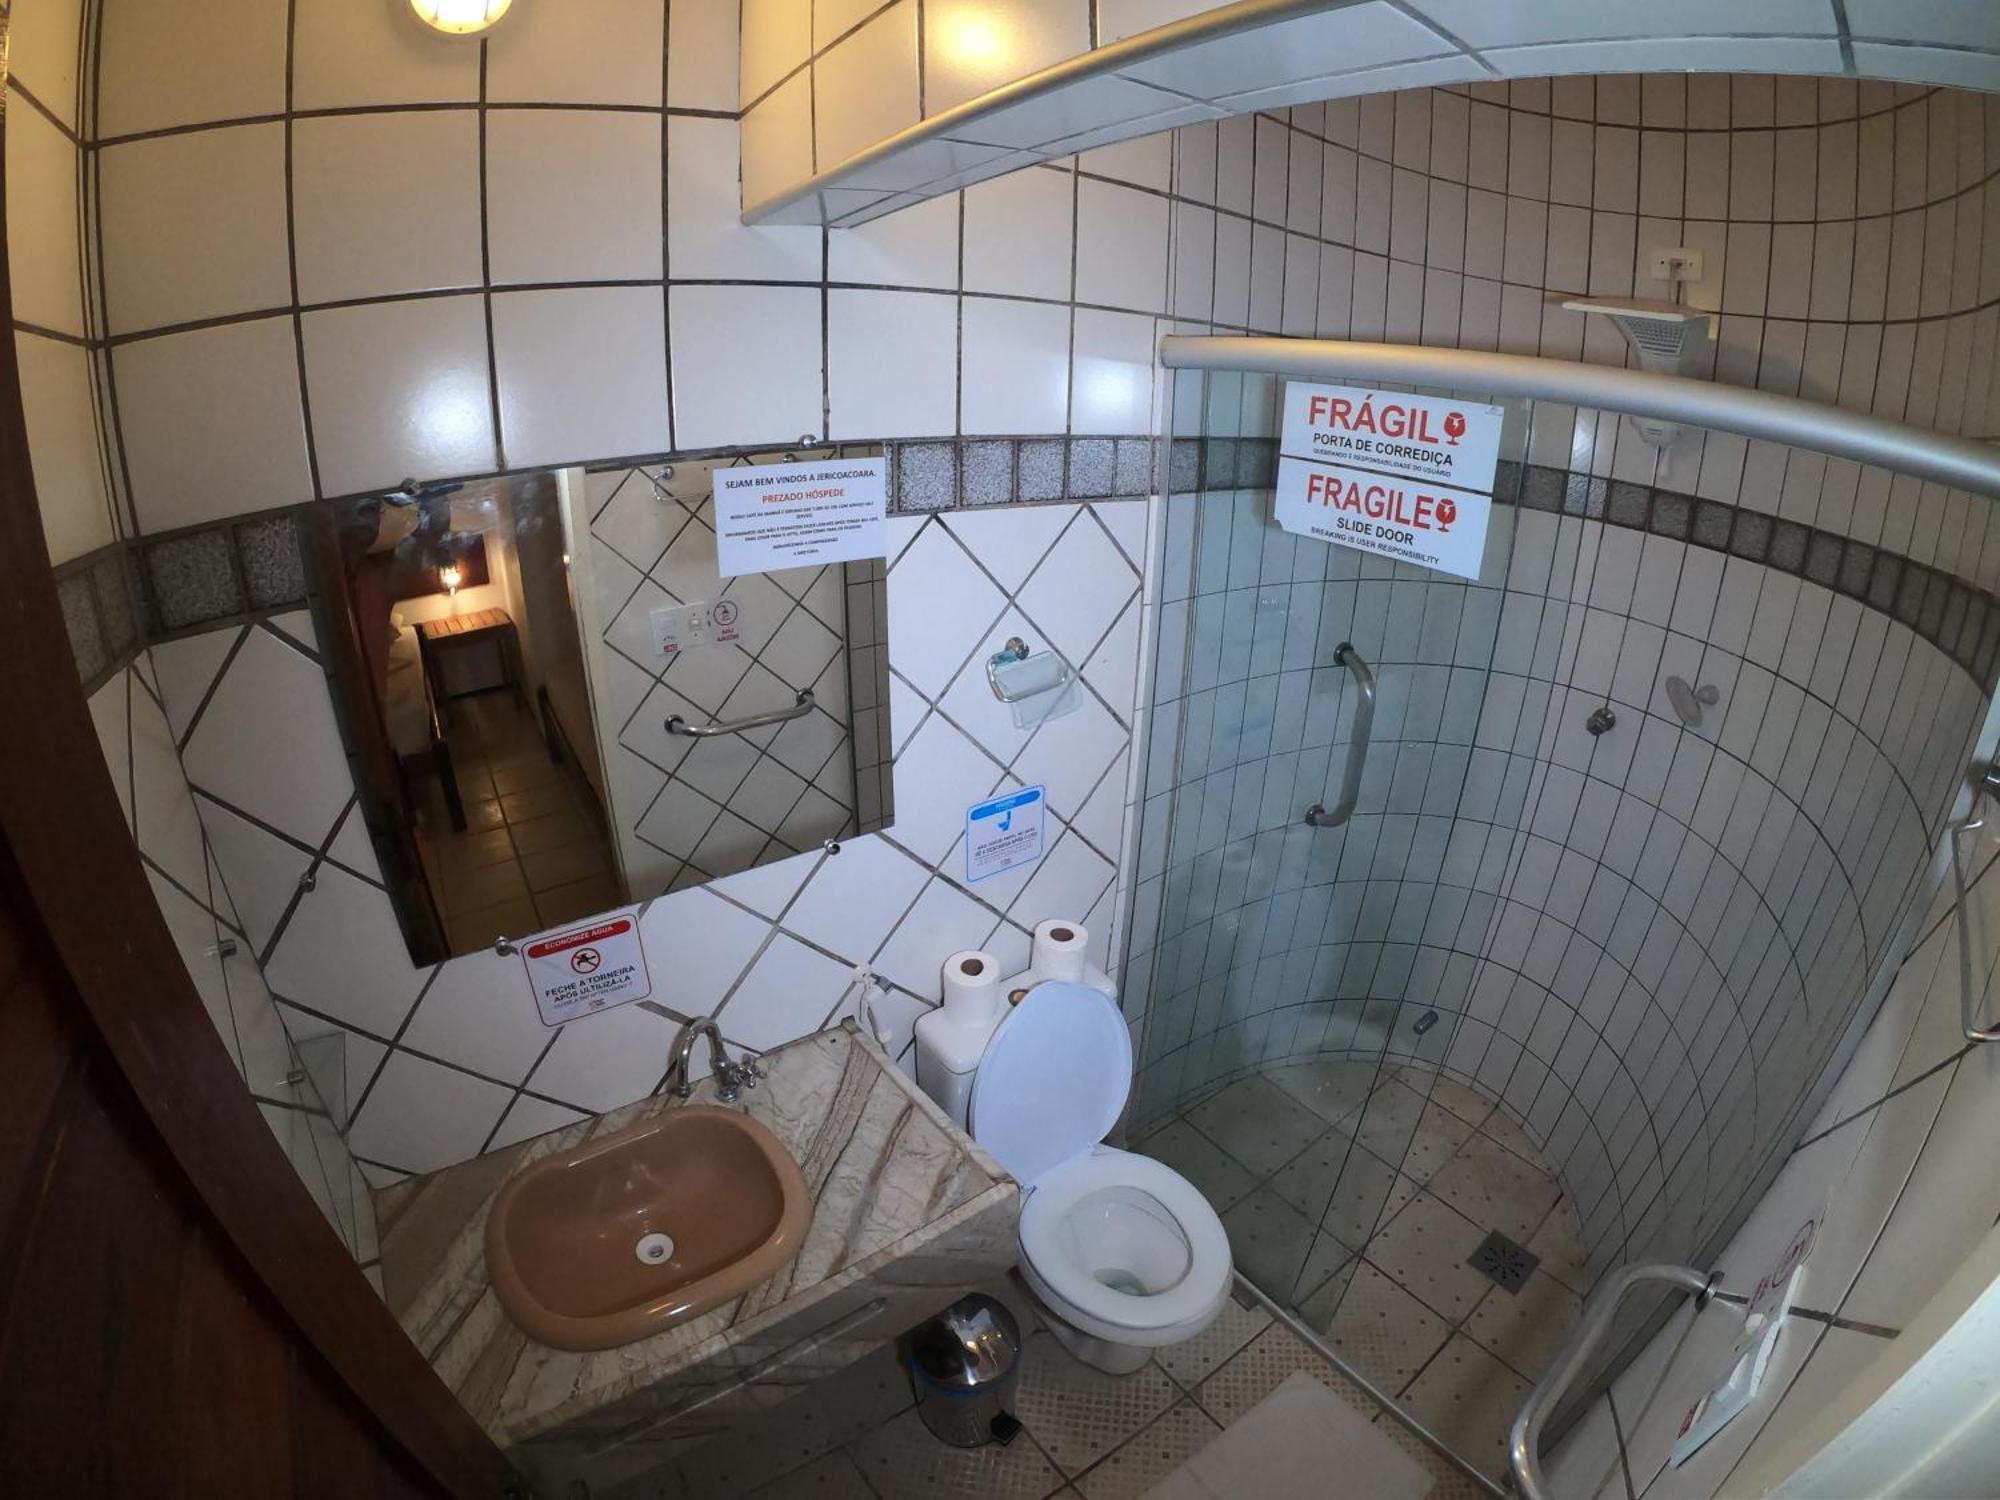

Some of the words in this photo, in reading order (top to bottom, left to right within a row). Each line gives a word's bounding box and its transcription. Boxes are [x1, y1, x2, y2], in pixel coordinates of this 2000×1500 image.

[1309, 394, 1439, 444] FRÁGIL
[1313, 432, 1352, 449] PORTA
[1356, 440, 1373, 452] DE
[1375, 442, 1453, 467] CORREDIÇA
[725, 479, 753, 489] SEJAM
[755, 477, 774, 486] BEM
[776, 474, 807, 484] VINDOS
[816, 469, 877, 482] JERICOACOARA.
[1412, 464, 1422, 472] DO
[762, 491, 803, 504] PREZADO
[806, 488, 845, 500] HÓSPEDE
[1307, 474, 1434, 530] FRAGILE
[1311, 526, 1346, 542] BREAKING
[1347, 535, 1355, 544] IS
[1356, 537, 1376, 549] USER
[1377, 542, 1440, 565] RESPONSIBILITY
[1337, 516, 1373, 536] SLIDE
[1375, 526, 1414, 546] DOOR
[544, 932, 590, 950] ECONOMIZE
[545, 982, 577, 998] FECHE
[579, 978, 587, 987] A
[588, 965, 636, 983] TORNEIRA
[554, 990, 578, 1003] APÓS
